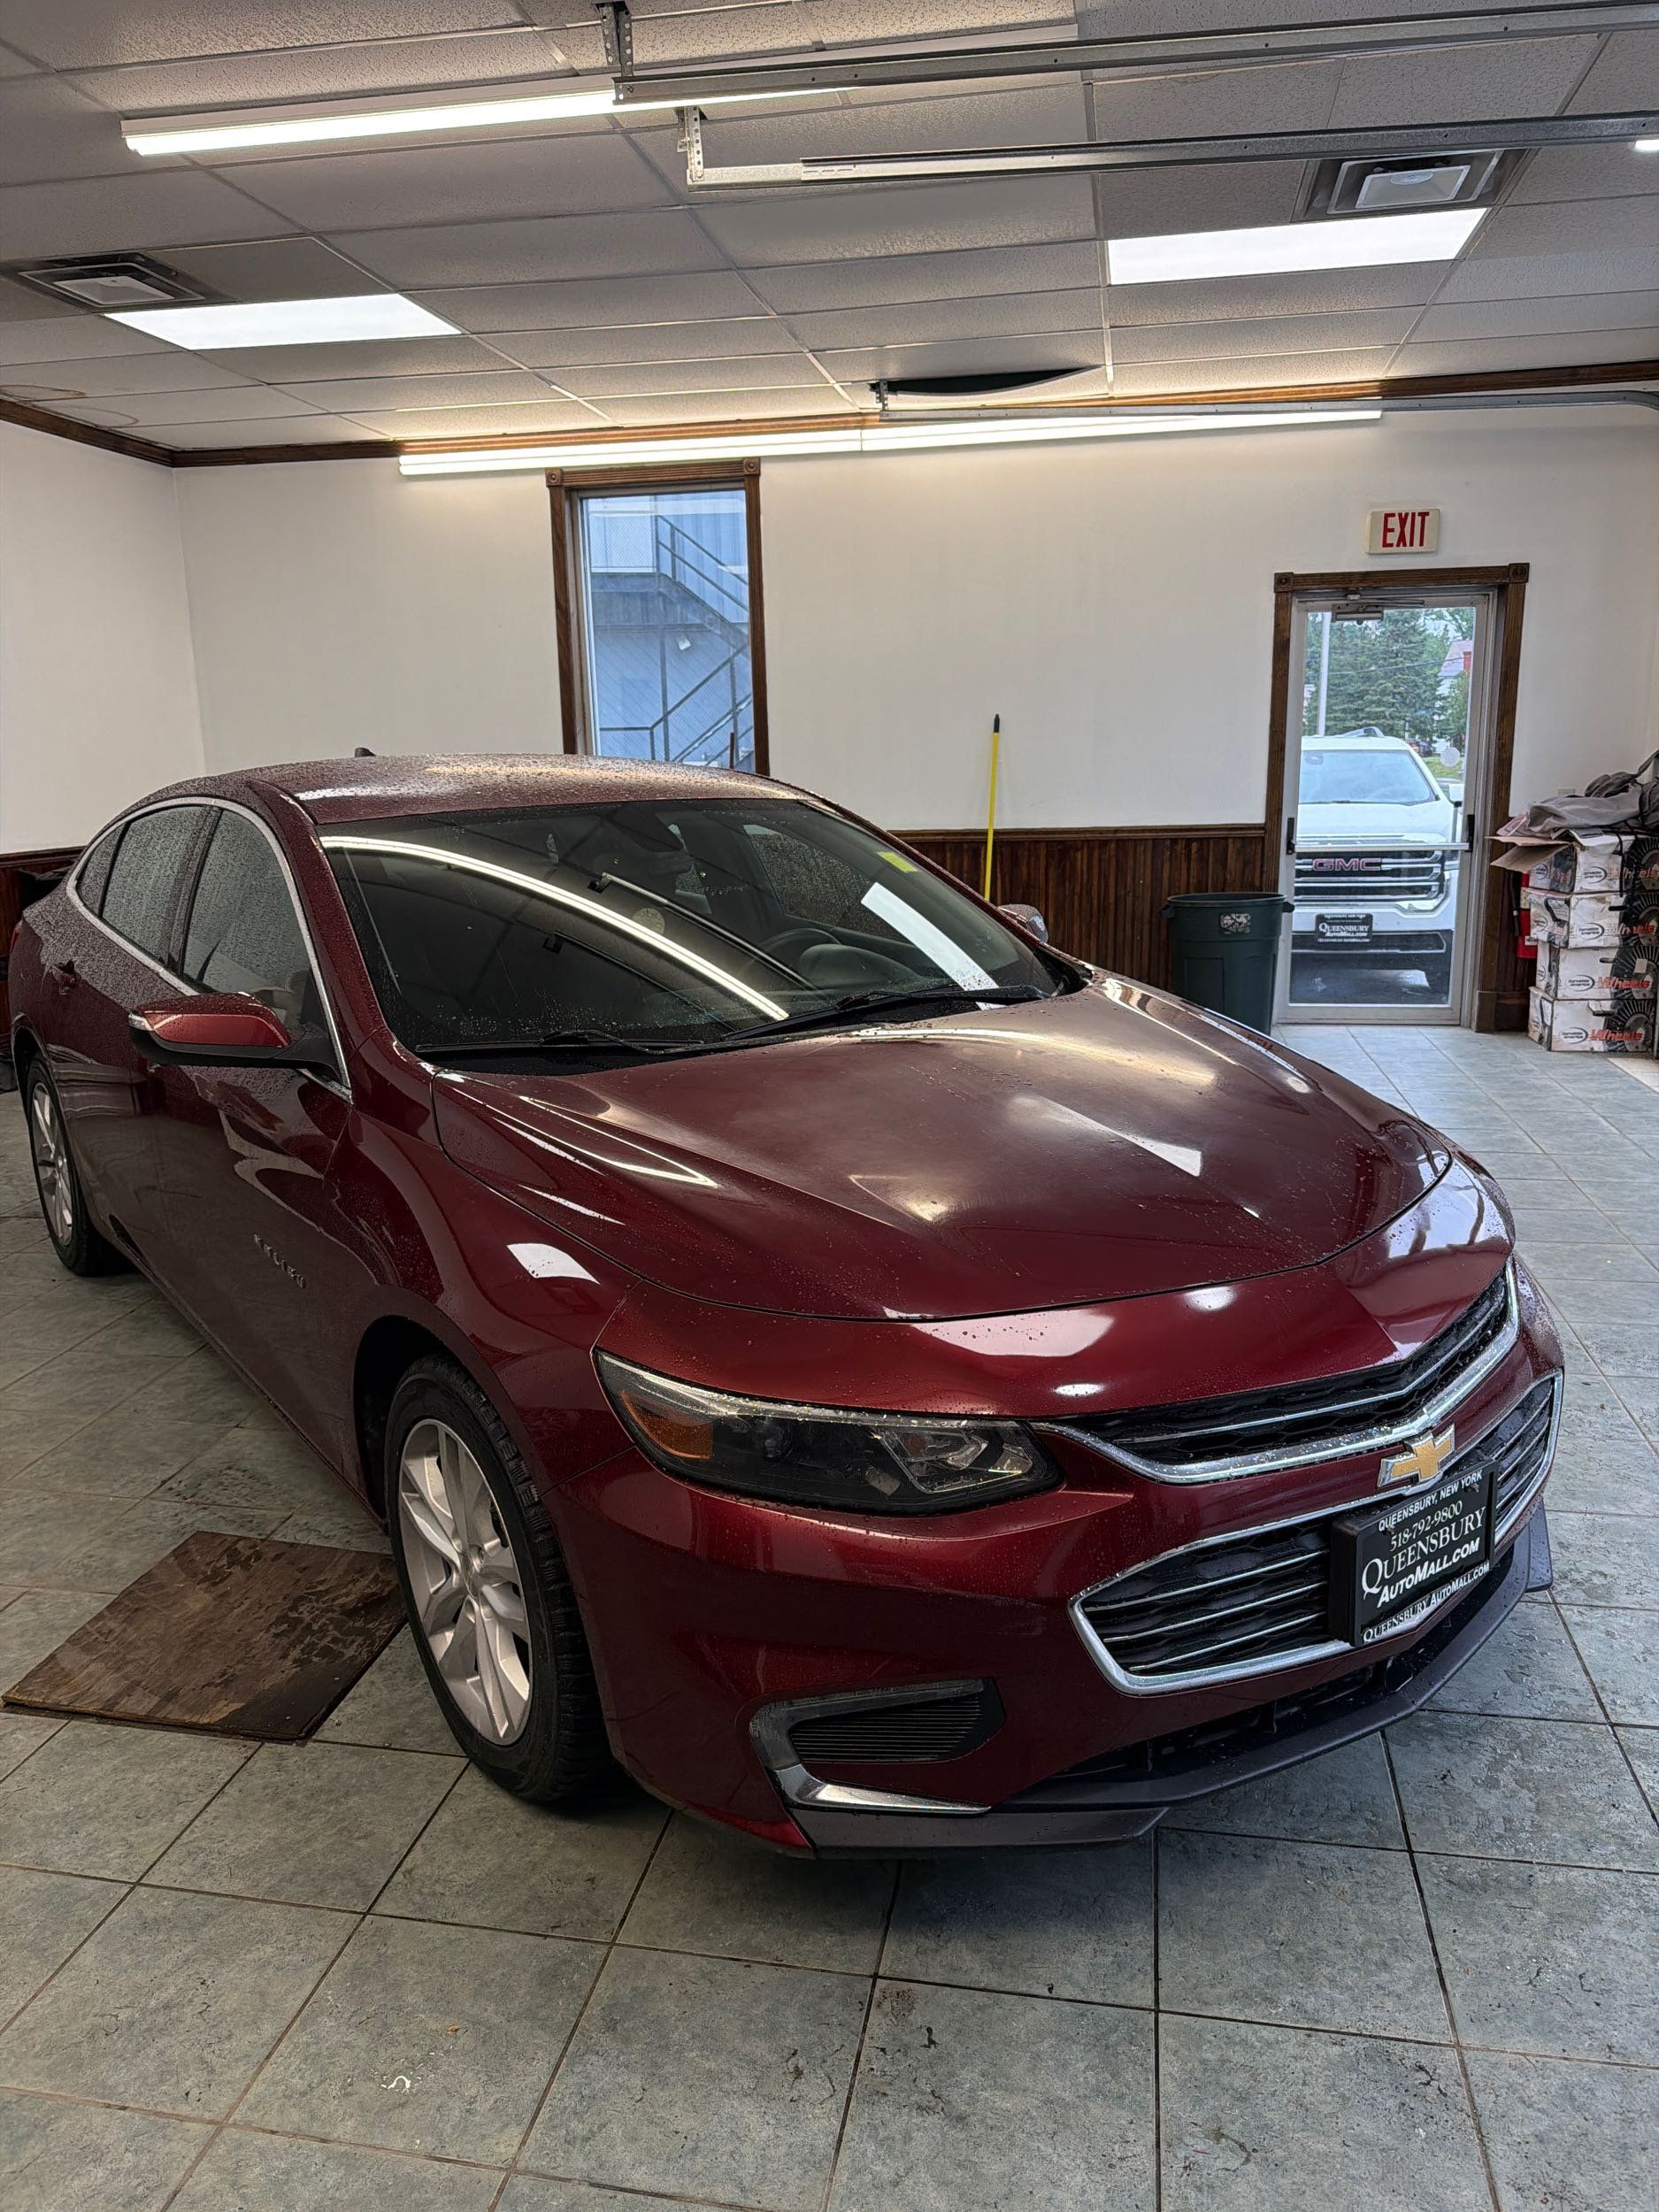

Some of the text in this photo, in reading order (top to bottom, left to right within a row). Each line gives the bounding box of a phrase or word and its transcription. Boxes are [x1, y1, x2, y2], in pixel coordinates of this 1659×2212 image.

[1382, 511, 1430, 548] EXIT
[1312, 857, 1382, 872] GMC
[1598, 976, 1651, 988] Wheels
[1589, 1029, 1644, 1041] Wheels
[1379, 1470, 1483, 1532] QUEENSBURY, NEW YORK
[1390, 1500, 1463, 1552] 518-792-9800
[1362, 1506, 1486, 1600] QUEENSBURY
[1377, 1537, 1480, 1609] AUTOMALL.COM
[1363, 1599, 1428, 1643] QUEENSBURY
